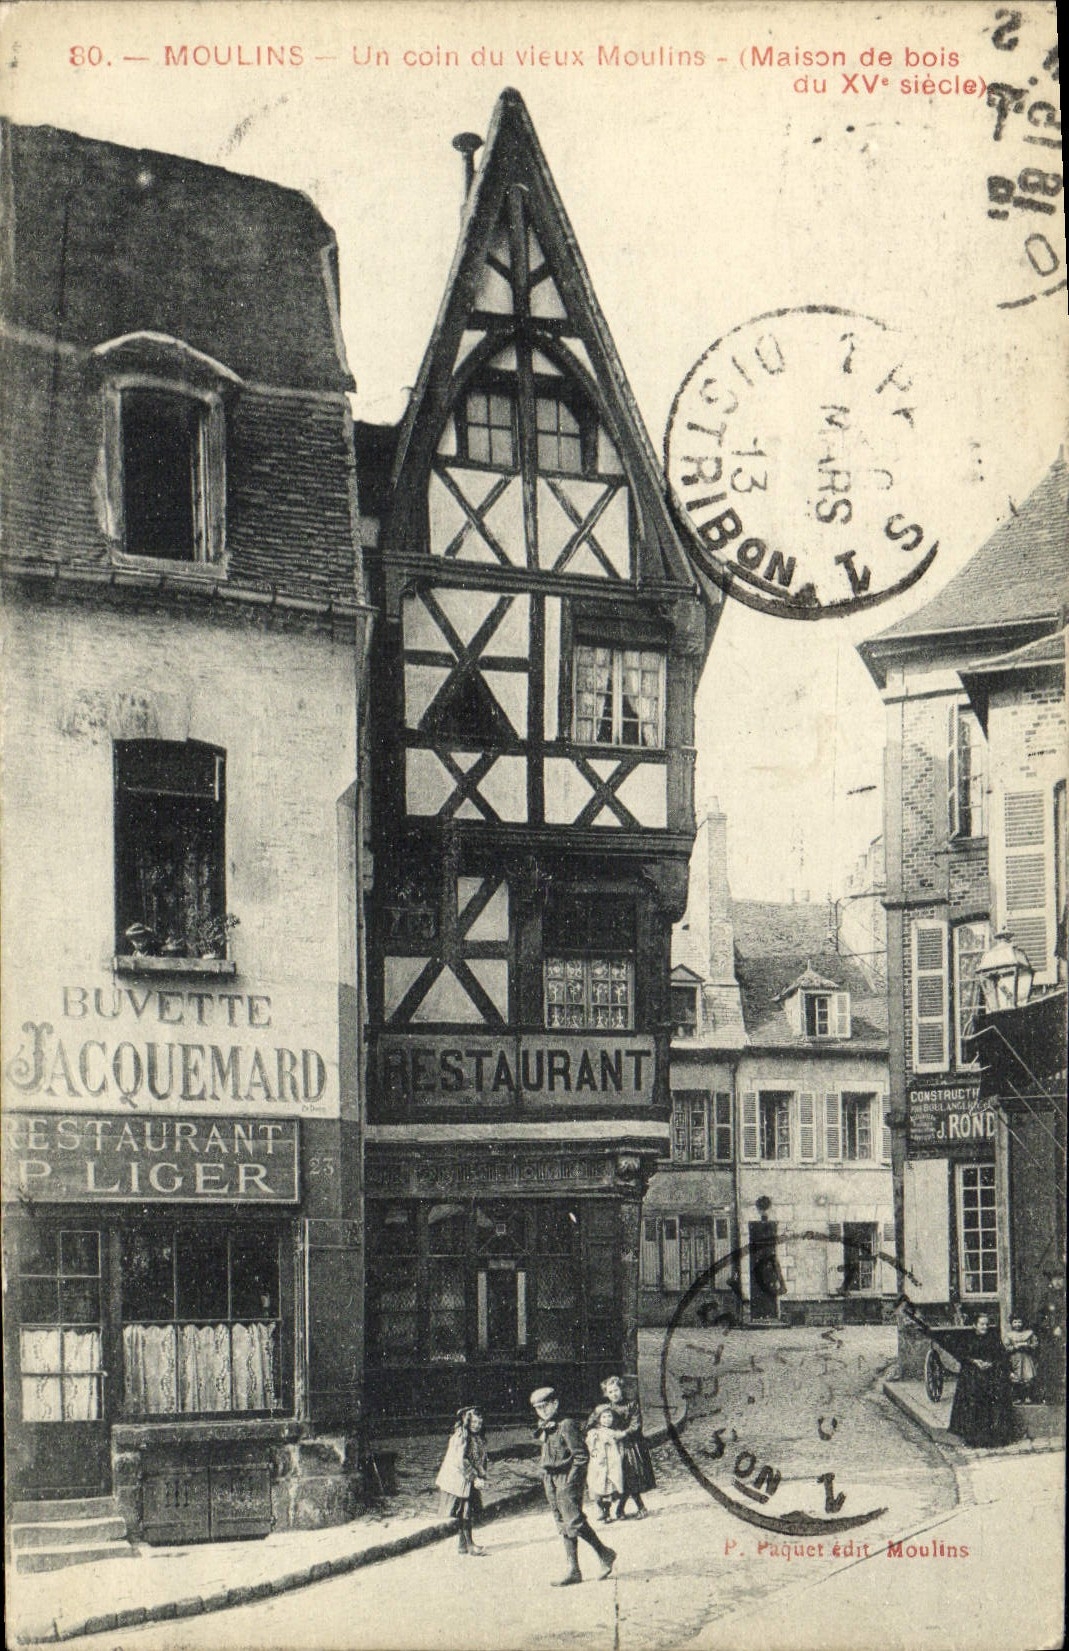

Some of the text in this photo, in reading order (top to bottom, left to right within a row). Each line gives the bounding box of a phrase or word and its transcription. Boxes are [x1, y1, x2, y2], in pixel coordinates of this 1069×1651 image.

[61, 985, 273, 1029] BUVETTE
[6, 1021, 329, 1109] JACQUEMARD
[382, 1048, 652, 1093] RESTAURANT
[3, 1116, 283, 1156] RESTAURANT
[85, 1160, 275, 1194] LIGER
